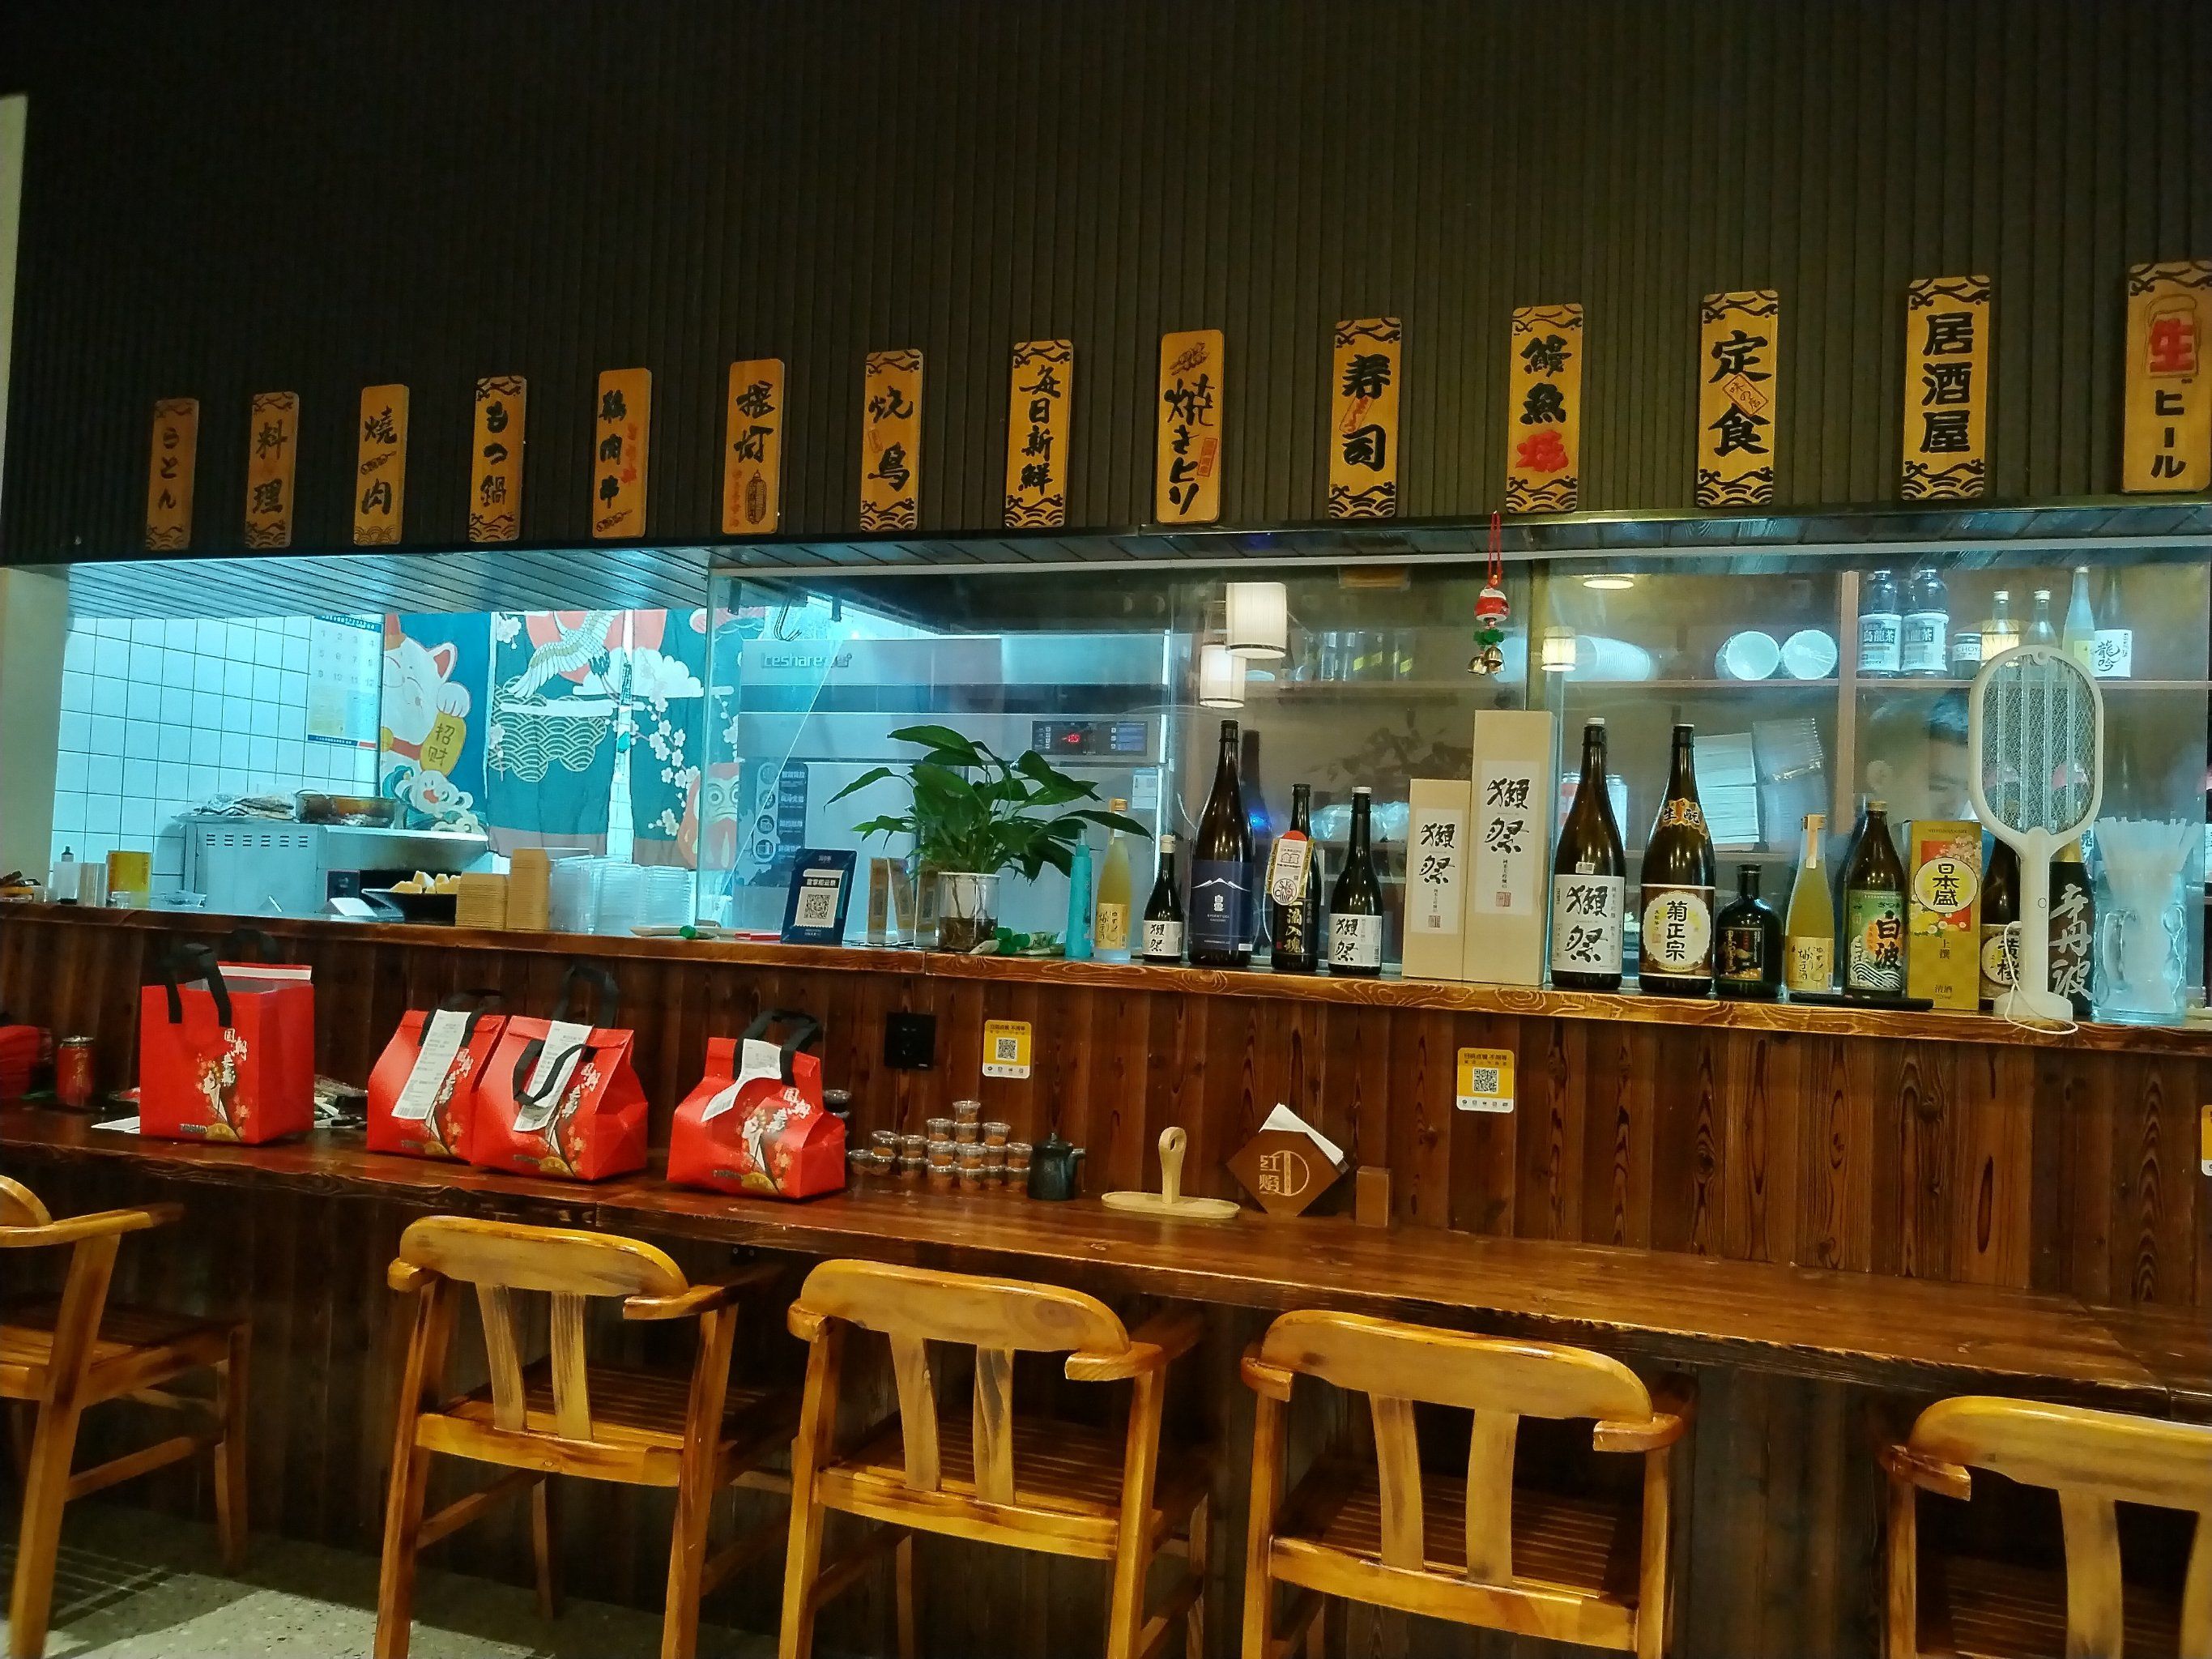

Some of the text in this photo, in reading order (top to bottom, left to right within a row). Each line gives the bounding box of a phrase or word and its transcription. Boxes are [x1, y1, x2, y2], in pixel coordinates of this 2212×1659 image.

[1707, 329, 1772, 458] 定食
[1920, 311, 1974, 454] 居酒屋
[251, 419, 288, 514] 料理
[428, 723, 456, 767] 招财
[1418, 822, 1455, 885] 獺祭
[1484, 778, 1531, 855] 獺祭
[1932, 863, 1960, 907] 日本盛
[1564, 885, 1609, 963] 獺祭
[1665, 900, 1689, 962] 菊正宗
[1873, 910, 1902, 970] 白波
[2048, 883, 2094, 1001] 辛丹波
